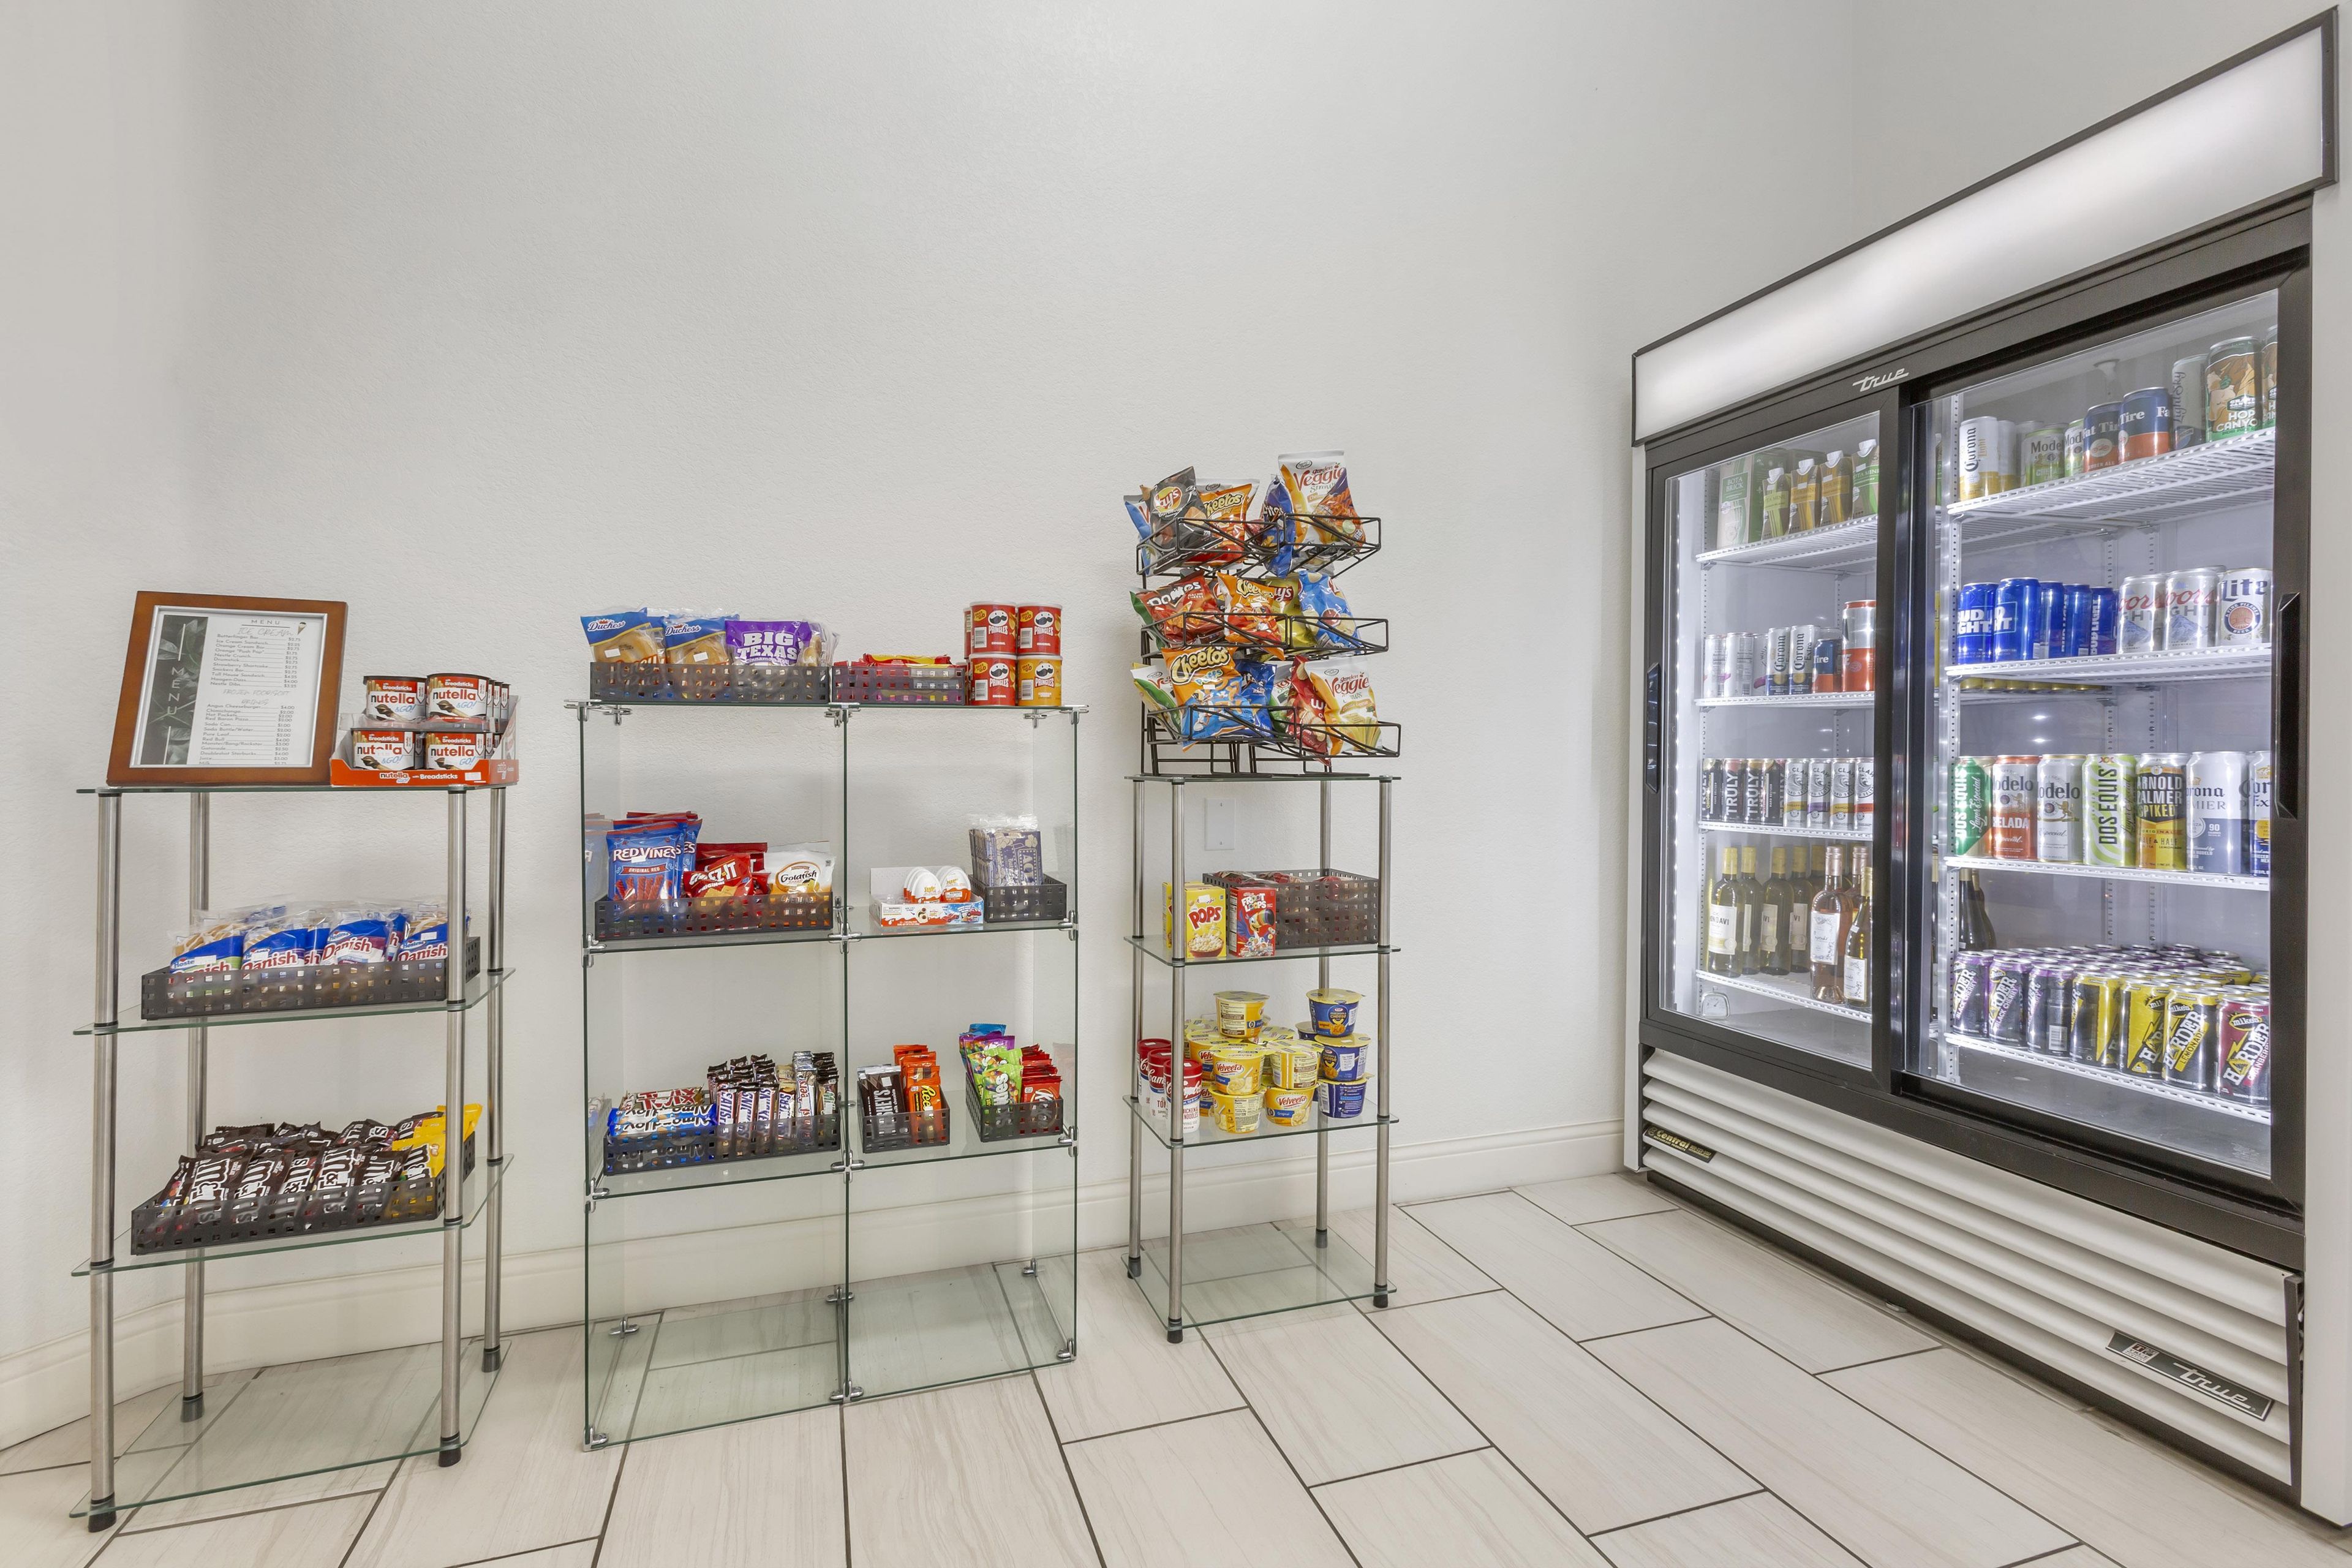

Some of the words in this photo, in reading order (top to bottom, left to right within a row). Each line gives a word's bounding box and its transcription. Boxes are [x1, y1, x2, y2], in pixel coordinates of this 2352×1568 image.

[2119, 411, 2144, 424] Tire
[2228, 410, 2255, 420] HOP
[2216, 418, 2258, 432] CANYO
[1964, 427, 1979, 472] Corona
[1726, 481, 1744, 492] BRICK
[1727, 477, 1743, 485] BOTA
[2222, 579, 2268, 602] Lite
[588, 620, 625, 631] Duchess
[666, 624, 701, 636] Duchess
[988, 625, 1008, 635] PRINGLES
[1034, 626, 1054, 636] PRINGLES
[257, 628, 294, 637] CREAM
[744, 631, 794, 646] BIG
[737, 645, 797, 660] TEXAS
[1773, 635, 1787, 672] Corona
[1793, 633, 1805, 671] Corona
[1170, 646, 1230, 684] Cheetos
[989, 678, 1009, 687] PRINGLES
[1035, 678, 1054, 687] PRINGLES
[1325, 677, 1370, 697] Veggie
[371, 693, 415, 704] nutella
[432, 689, 476, 701] nutella
[431, 745, 474, 756] nutella
[2098, 767, 2119, 812] EQUIS
[2138, 776, 2182, 790] ARNOLD
[1726, 774, 1738, 815] TRULY
[1747, 772, 1759, 816] TRULY
[2039, 782, 2081, 799] odelo
[2098, 816, 2117, 844] DOS
[780, 870, 818, 883] Goldfish
[1242, 893, 1266, 906] FROOT
[1244, 901, 1267, 912] LOOPS
[1188, 907, 1222, 930] POPS
[330, 931, 351, 941] Hostess
[401, 940, 426, 949] Hostess
[398, 945, 447, 961] Danish
[174, 959, 195, 968] Hoste
[241, 951, 298, 970] Danish
[2164, 1011, 2207, 1069] HARDER
[2223, 1023, 2269, 1085] HARDER
[1216, 1061, 1242, 1072] Velveeta
[1278, 1095, 1306, 1106] Velveeta
[1657, 1129, 1691, 1150] Central
